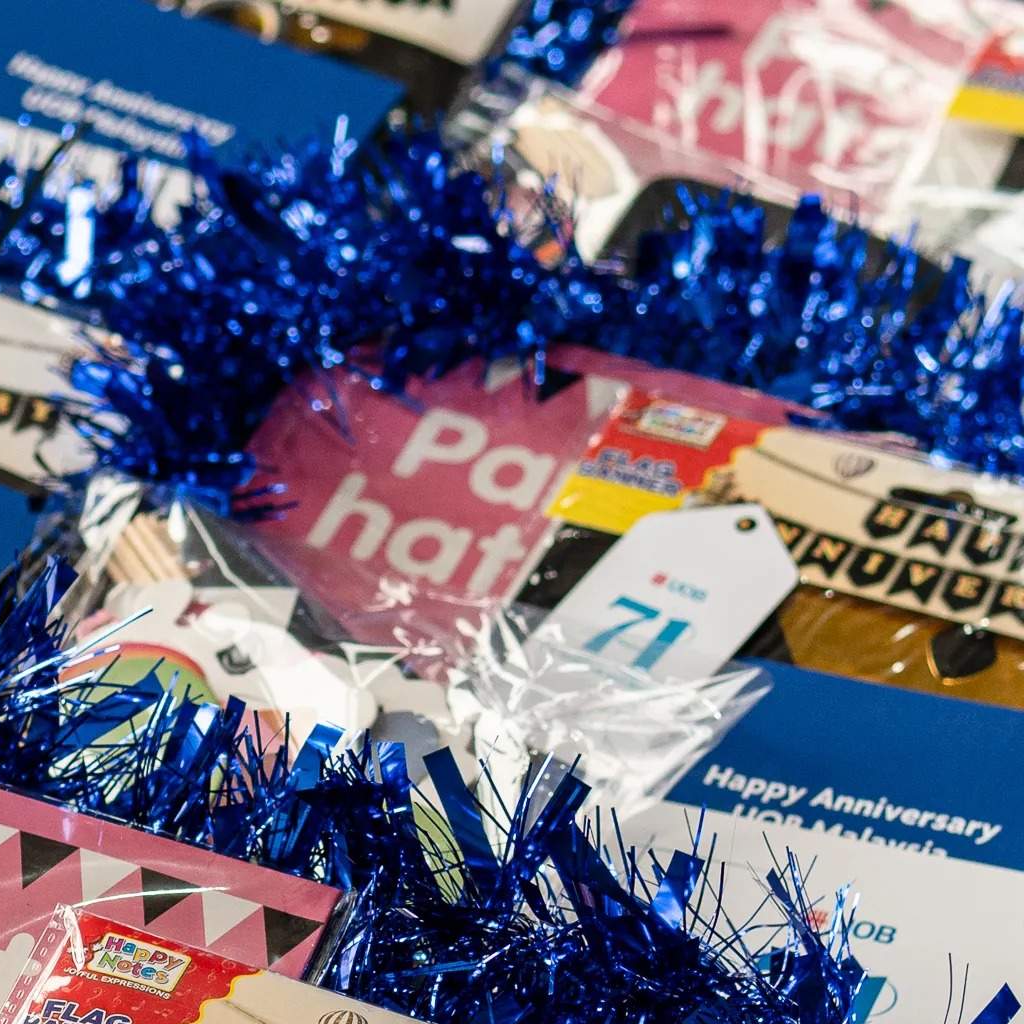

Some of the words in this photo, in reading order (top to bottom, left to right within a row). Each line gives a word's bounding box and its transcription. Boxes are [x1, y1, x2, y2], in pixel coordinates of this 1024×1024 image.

[583, 596, 690, 672] 71
[703, 764, 808, 807] Happy
[809, 787, 1002, 845] Anniversary
[97, 952, 170, 985] Notes
[105, 935, 184, 973] Happy
[63, 966, 99, 982] JOYFUL
[101, 976, 172, 1000] EXPRESSIONS
